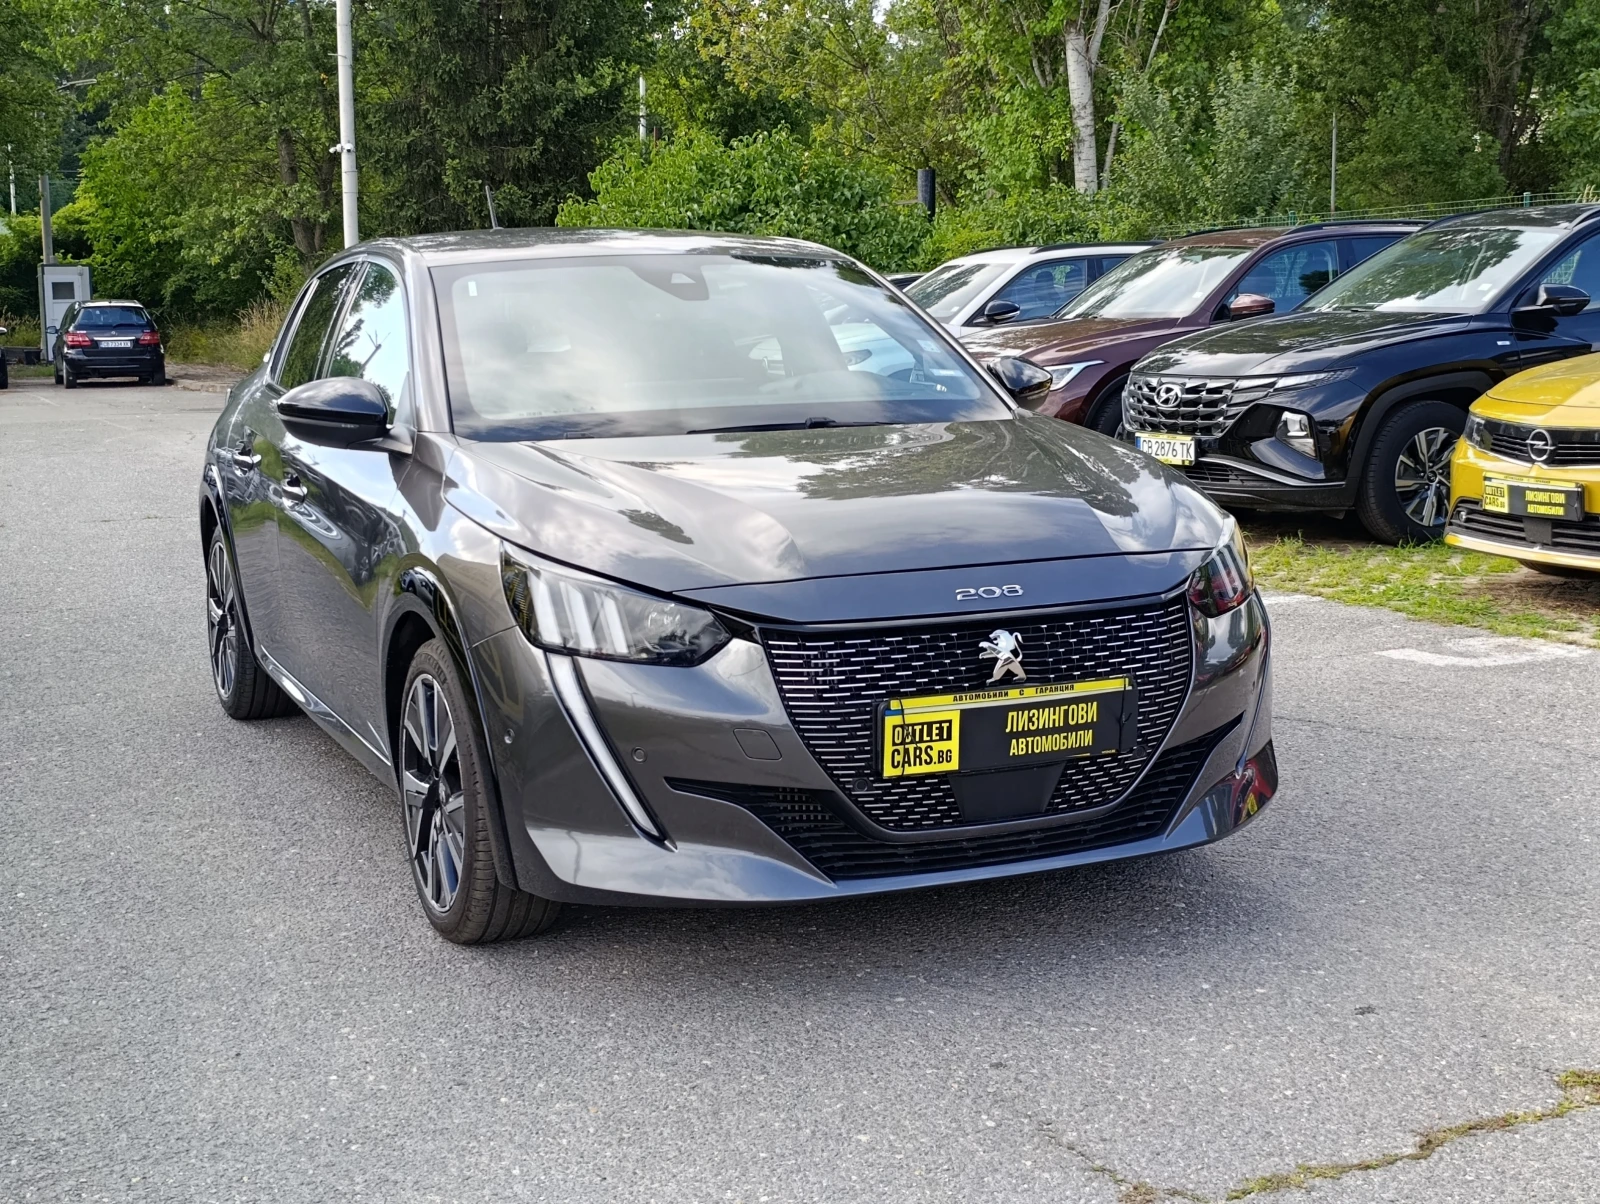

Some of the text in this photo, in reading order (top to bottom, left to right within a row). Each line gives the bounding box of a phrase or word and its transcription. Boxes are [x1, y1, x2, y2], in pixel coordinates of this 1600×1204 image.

[1142, 439, 1193, 459] CB 2876 TK
[1485, 486, 1504, 498] OUTLET
[1525, 490, 1565, 504] ЛИЗИНГОВИ
[1527, 503, 1564, 516] АВТОМОБИЛИ
[955, 584, 1024, 601] 208
[953, 690, 1009, 703] АВТОМОБИЛИ
[1035, 684, 1075, 695] ГАРАНЦИЯ
[1005, 701, 1098, 733] ЛИЗИНГОВИ
[894, 722, 950, 744] OUTLET
[1009, 729, 1093, 757] АВТОМОБИЛИ
[891, 745, 953, 769] CARS.BG
